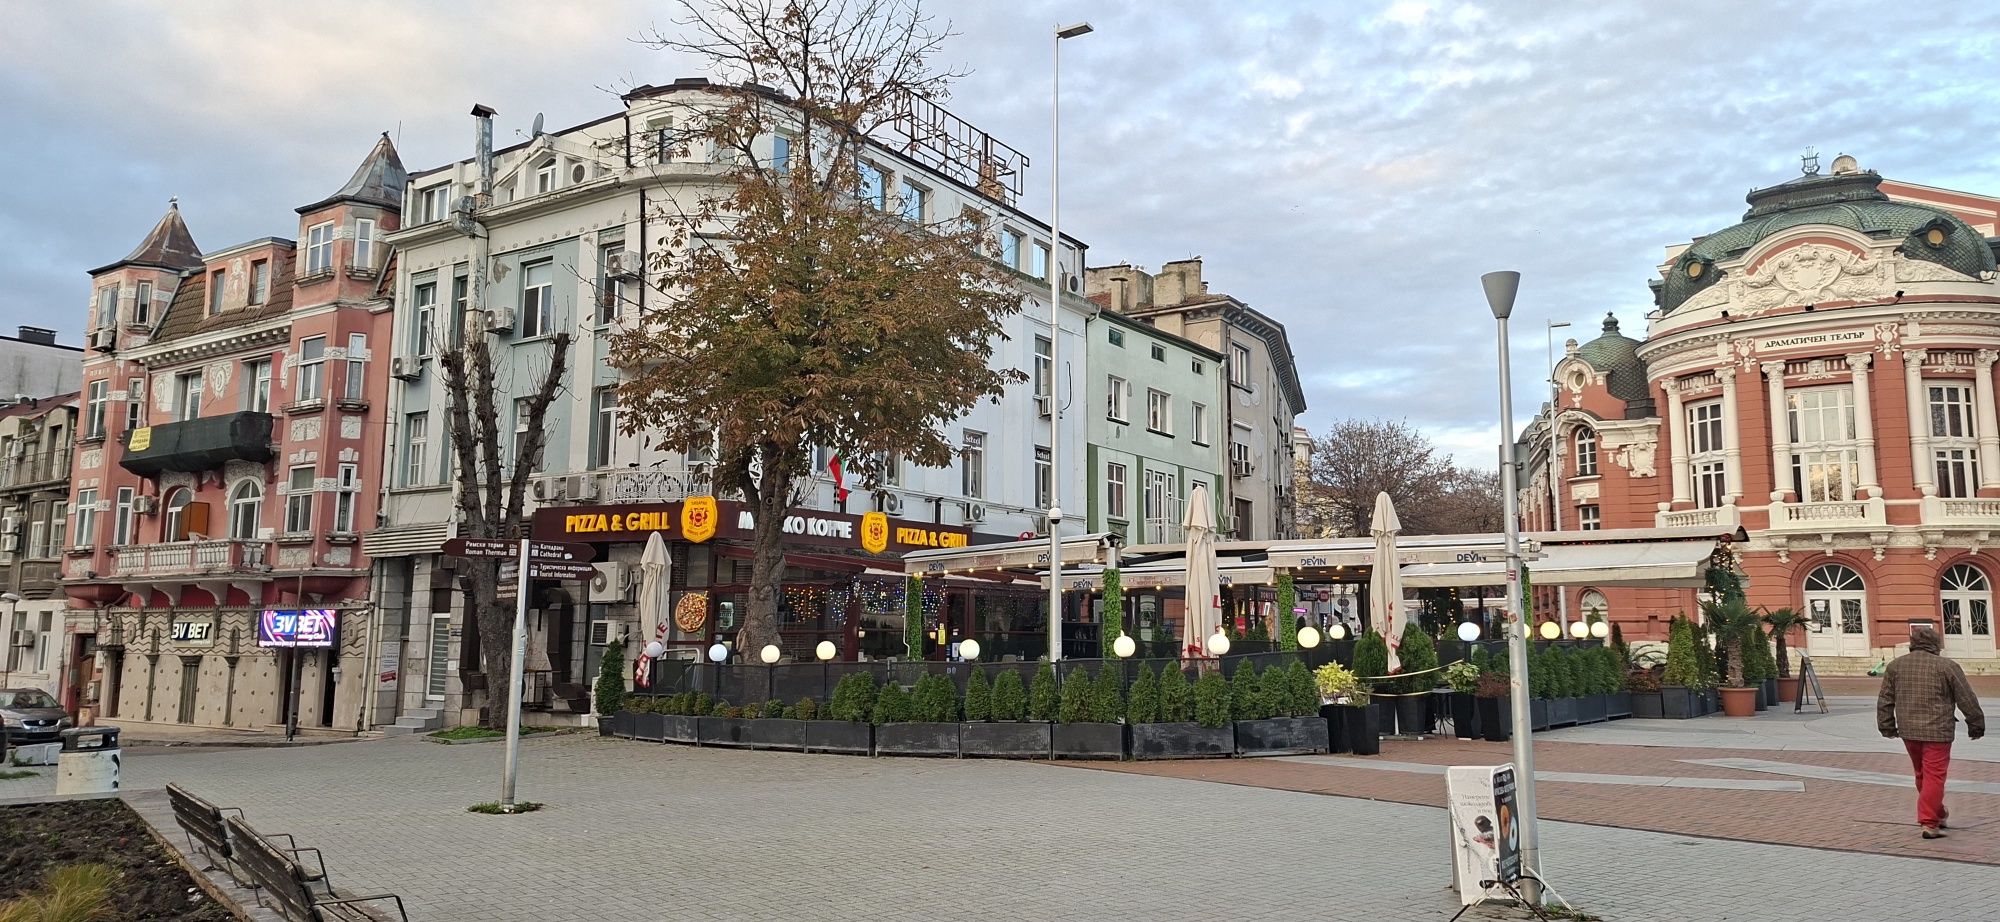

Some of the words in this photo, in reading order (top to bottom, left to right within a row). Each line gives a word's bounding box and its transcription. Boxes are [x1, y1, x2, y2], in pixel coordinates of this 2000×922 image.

[1765, 335, 1826, 347] ДРАМАТИЧЕН
[1830, 331, 1865, 341] ТЕАТЪР
[565, 513, 608, 533] PIZZA
[611, 514, 623, 531] &
[626, 512, 670, 531] GRILL
[896, 527, 928, 546] PIZZA
[929, 530, 938, 547] &
[939, 532, 968, 549] GRILL
[1037, 551, 1050, 563] DEV
[1300, 556, 1327, 566] DEVIN
[928, 561, 945, 571] DEVIN
[1072, 579, 1093, 588] DEVIN
[1218, 575, 1233, 584] VIN
